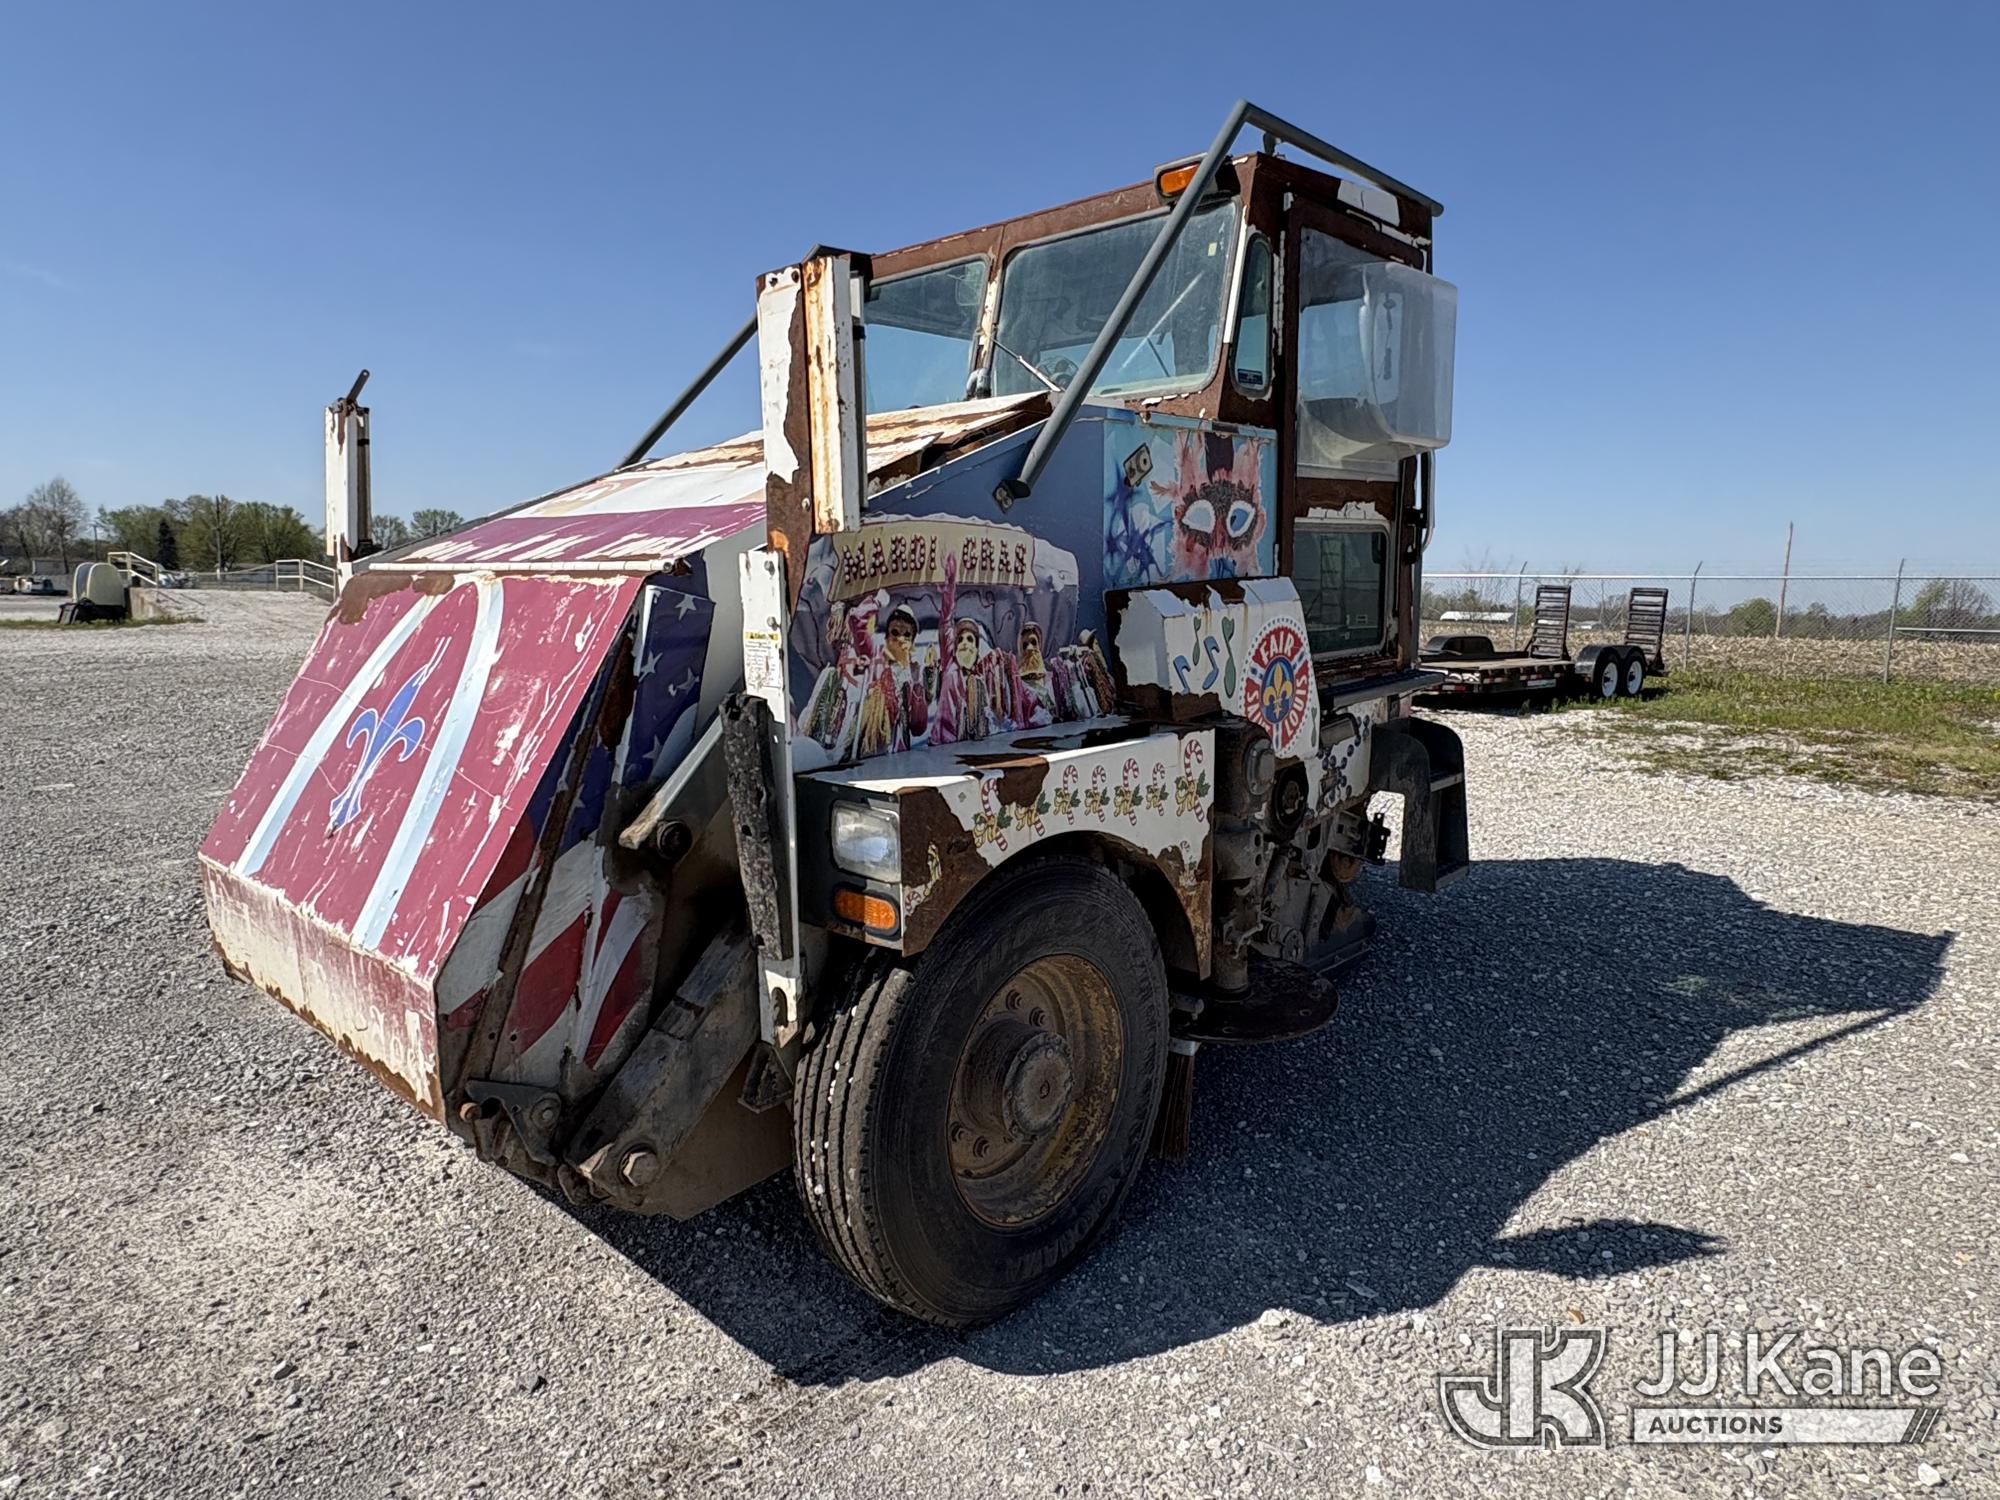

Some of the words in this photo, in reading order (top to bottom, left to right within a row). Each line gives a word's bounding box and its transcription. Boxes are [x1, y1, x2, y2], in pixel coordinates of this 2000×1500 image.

[843, 534, 938, 584] MARDI
[962, 536, 1027, 574] GRAS
[1259, 631, 1295, 665] FAIR
[1284, 675, 1307, 737] LOUIS
